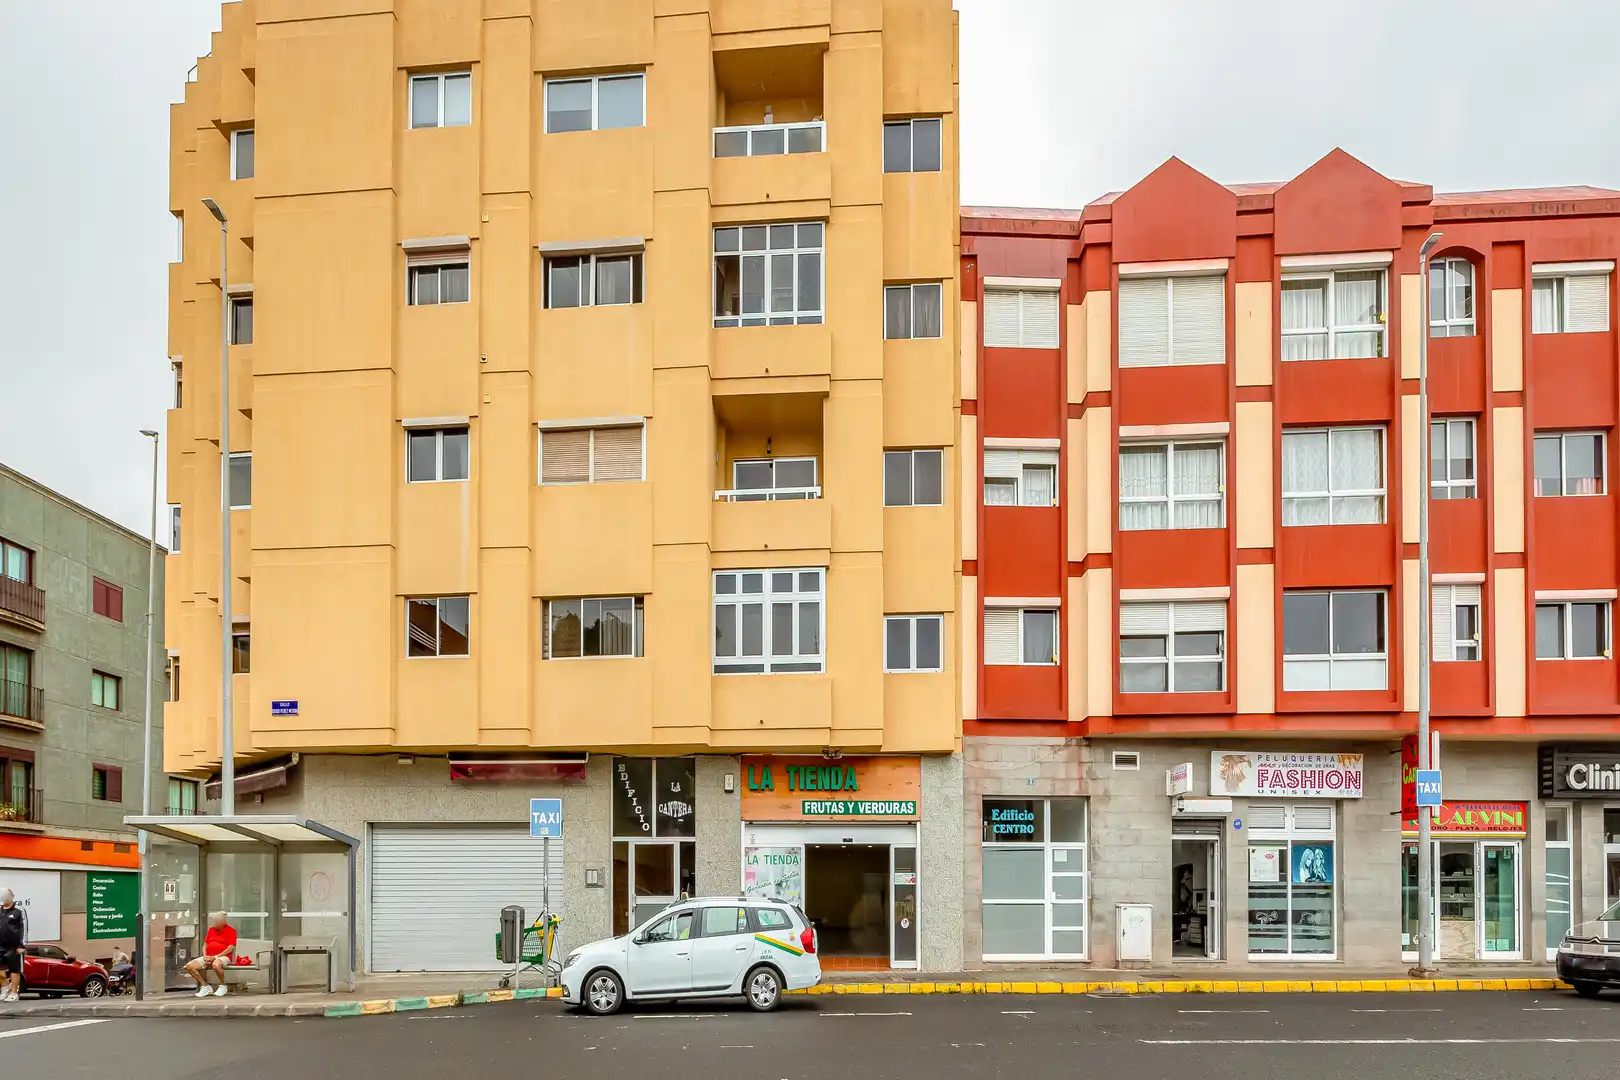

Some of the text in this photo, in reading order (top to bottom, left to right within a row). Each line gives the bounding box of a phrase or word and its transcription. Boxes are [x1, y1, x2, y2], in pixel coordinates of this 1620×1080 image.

[1257, 754, 1336, 763] PELUQUERIA
[748, 765, 858, 792] LA TIENDA
[1257, 769, 1361, 790] FASHION
[670, 782, 681, 792] LA
[1418, 782, 1440, 793] TAXI
[617, 764, 650, 831] EDIFICIO
[658, 800, 693, 818] CANTERA
[804, 801, 914, 814] FRUTAS Y VERDURAS
[532, 812, 560, 824] TAXI
[991, 808, 1035, 821] Edificio
[993, 824, 1035, 834] CENTRO
[747, 854, 799, 865] LA TIENDA
